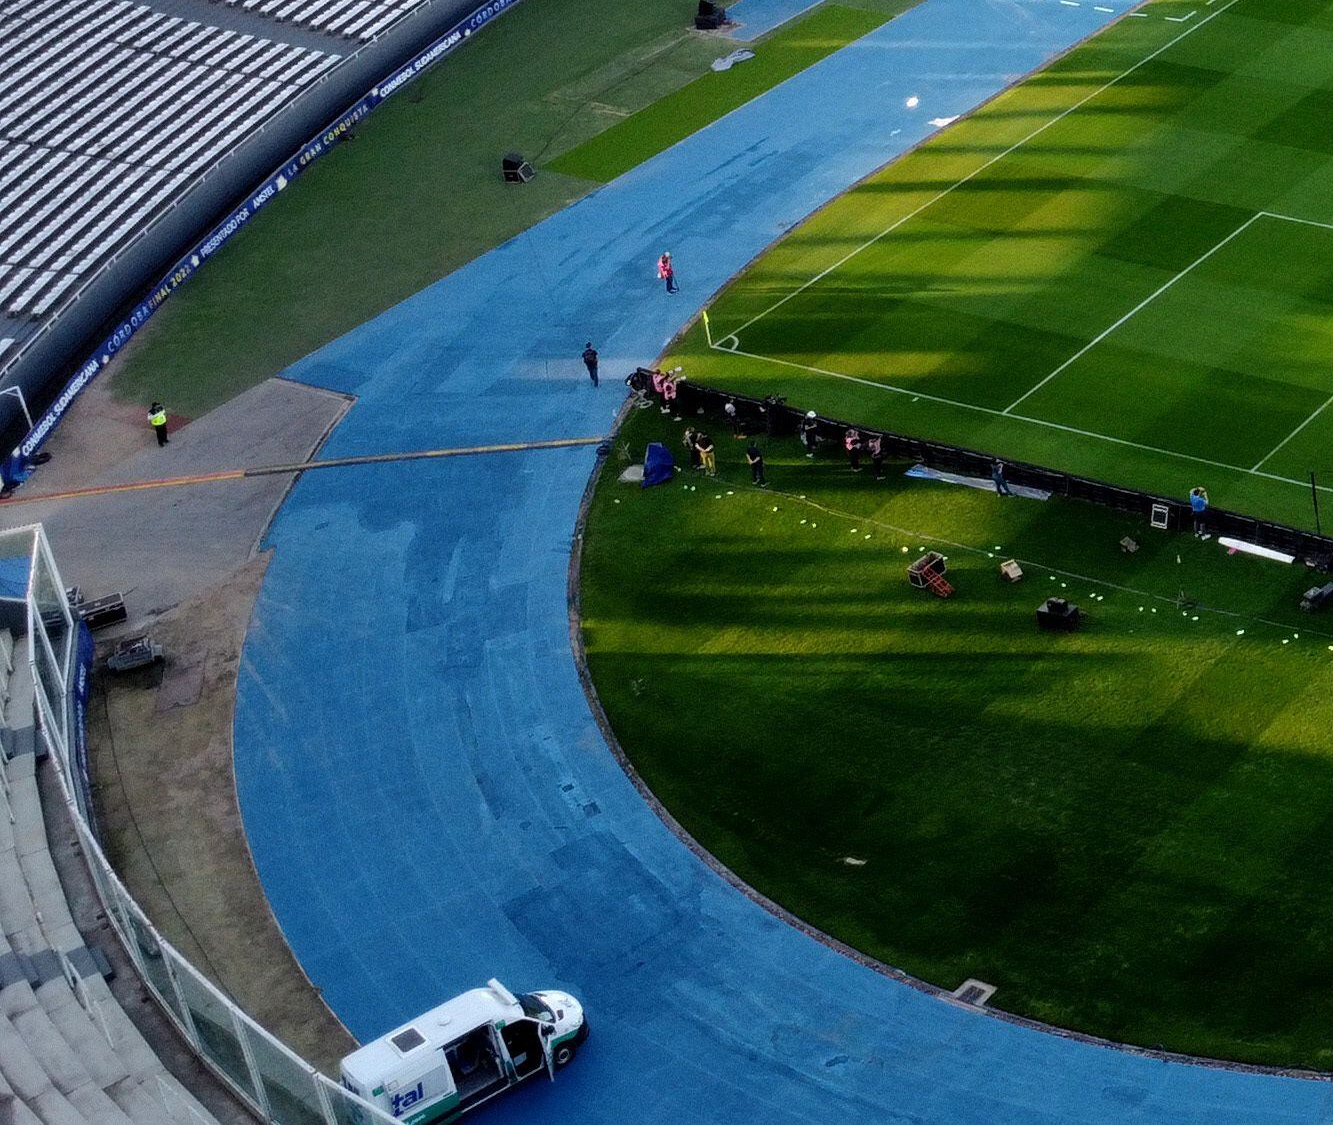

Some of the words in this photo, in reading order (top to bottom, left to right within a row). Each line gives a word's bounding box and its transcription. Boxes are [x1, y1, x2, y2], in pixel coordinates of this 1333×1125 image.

[379, 67, 416, 97] CONMEBOL
[300, 143, 322, 165] GRAN
[323, 104, 369, 145] CONQUISTA
[200, 220, 238, 258] PRESENTADO
[236, 208, 250, 225] POR
[22, 414, 56, 457] CONMEBOL
[53, 359, 99, 416] SUDAMERICANA
